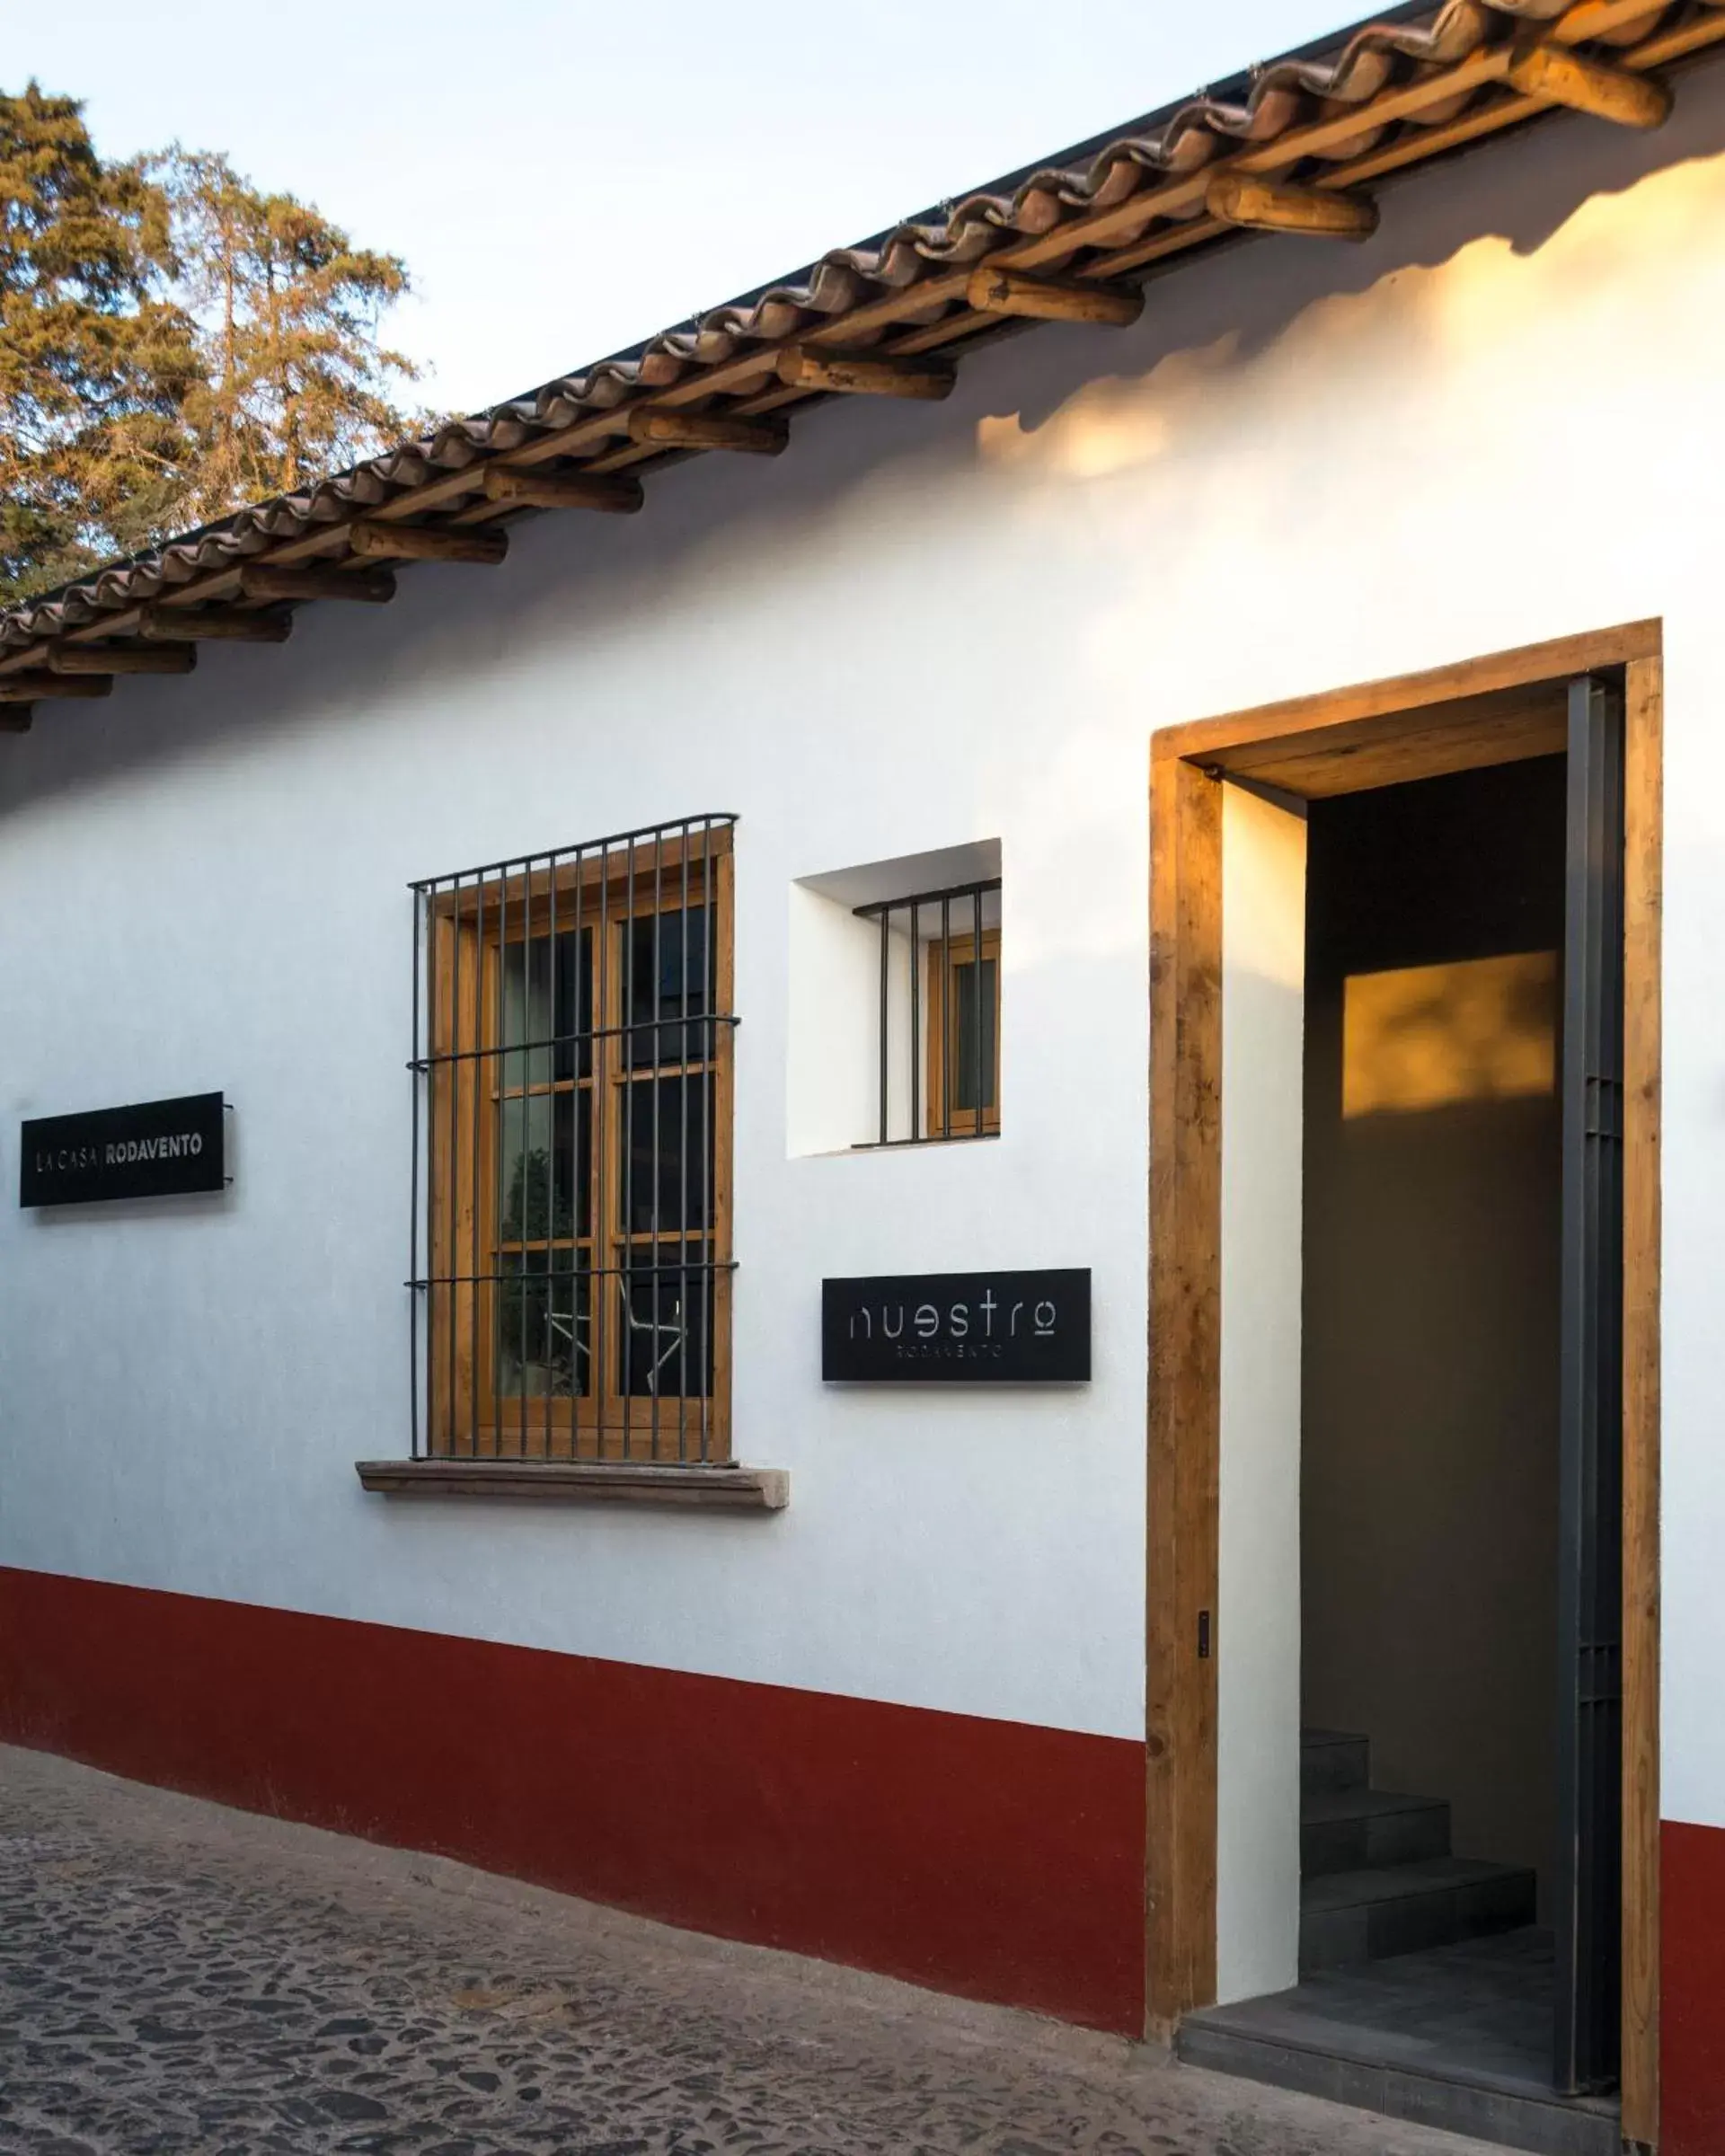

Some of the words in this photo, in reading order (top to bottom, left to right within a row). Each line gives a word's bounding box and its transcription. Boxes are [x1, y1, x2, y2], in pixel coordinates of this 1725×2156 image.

[35, 1150, 53, 1172] LA
[58, 1146, 98, 1171] CASA
[105, 1132, 203, 1164] RODAVENTO
[849, 1287, 1057, 1339] nuestro
